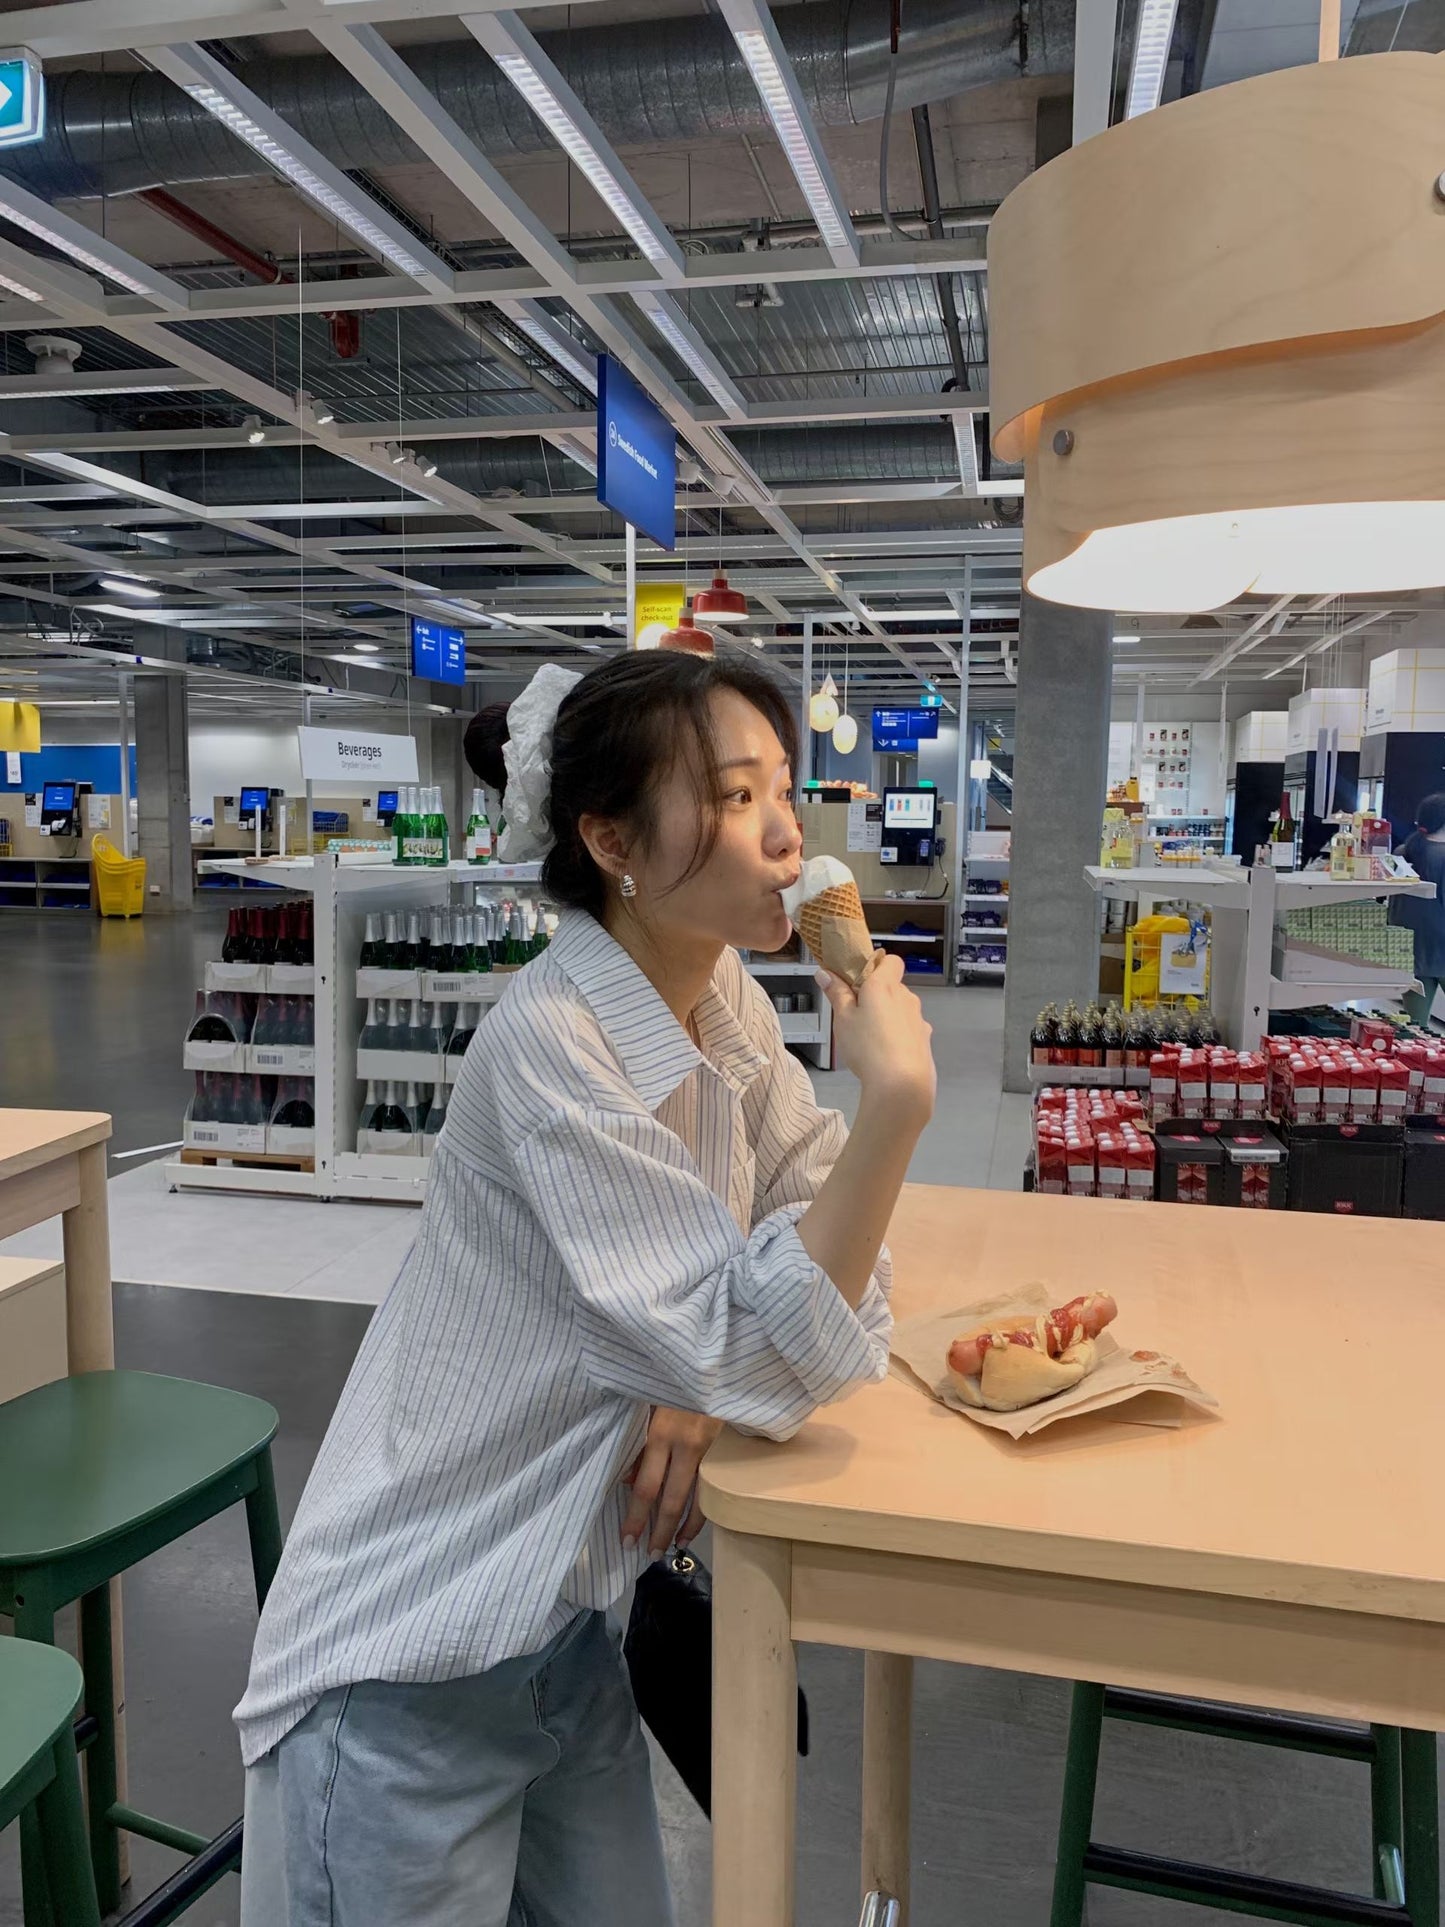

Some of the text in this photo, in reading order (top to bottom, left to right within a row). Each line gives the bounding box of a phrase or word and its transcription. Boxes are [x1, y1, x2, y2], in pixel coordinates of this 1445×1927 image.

[617, 433, 658, 480] Swedish Food Market
[641, 605, 672, 613] Self-scan
[338, 741, 382, 760] Beverages
